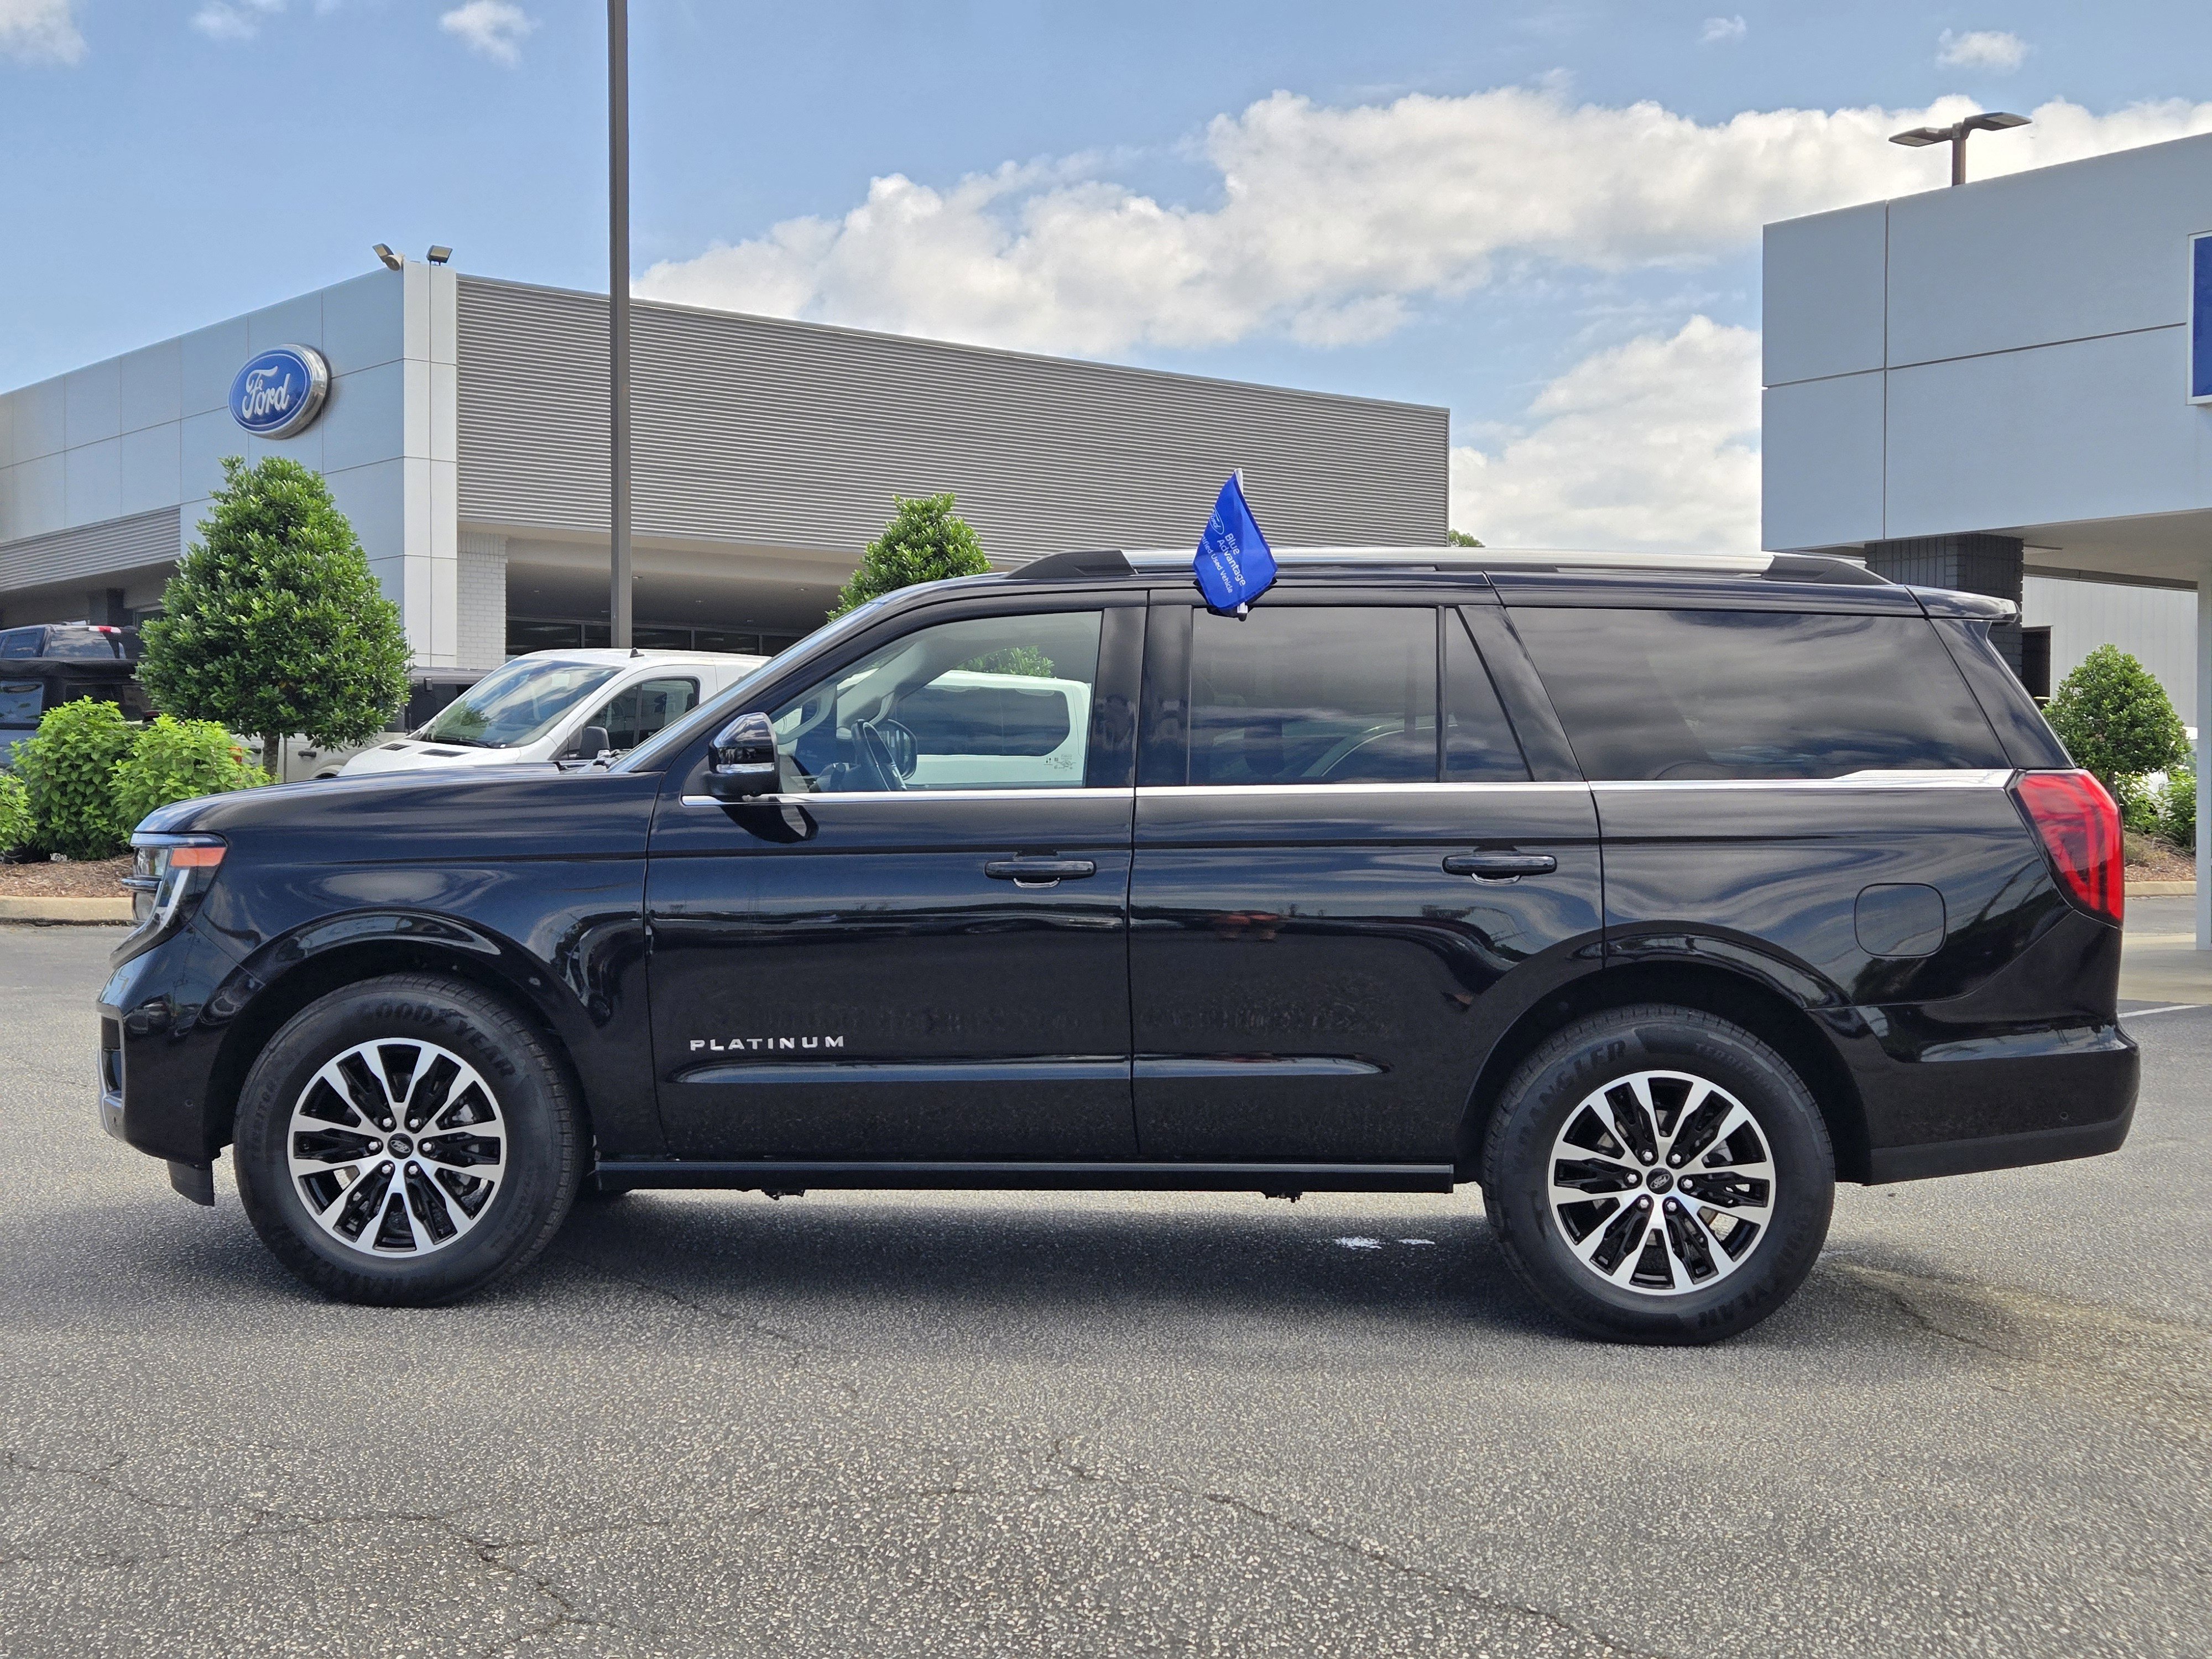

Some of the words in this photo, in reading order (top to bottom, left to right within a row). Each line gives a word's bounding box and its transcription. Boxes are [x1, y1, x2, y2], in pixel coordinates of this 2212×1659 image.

[242, 366, 290, 419] Ford
[1202, 535, 1214, 554] tified
[1211, 553, 1223, 571] Used
[1220, 570, 1233, 593] Vehicle
[1217, 539, 1246, 586] Advantage
[1224, 533, 1240, 555] Blue
[690, 1036, 844, 1051] PLATINUM
